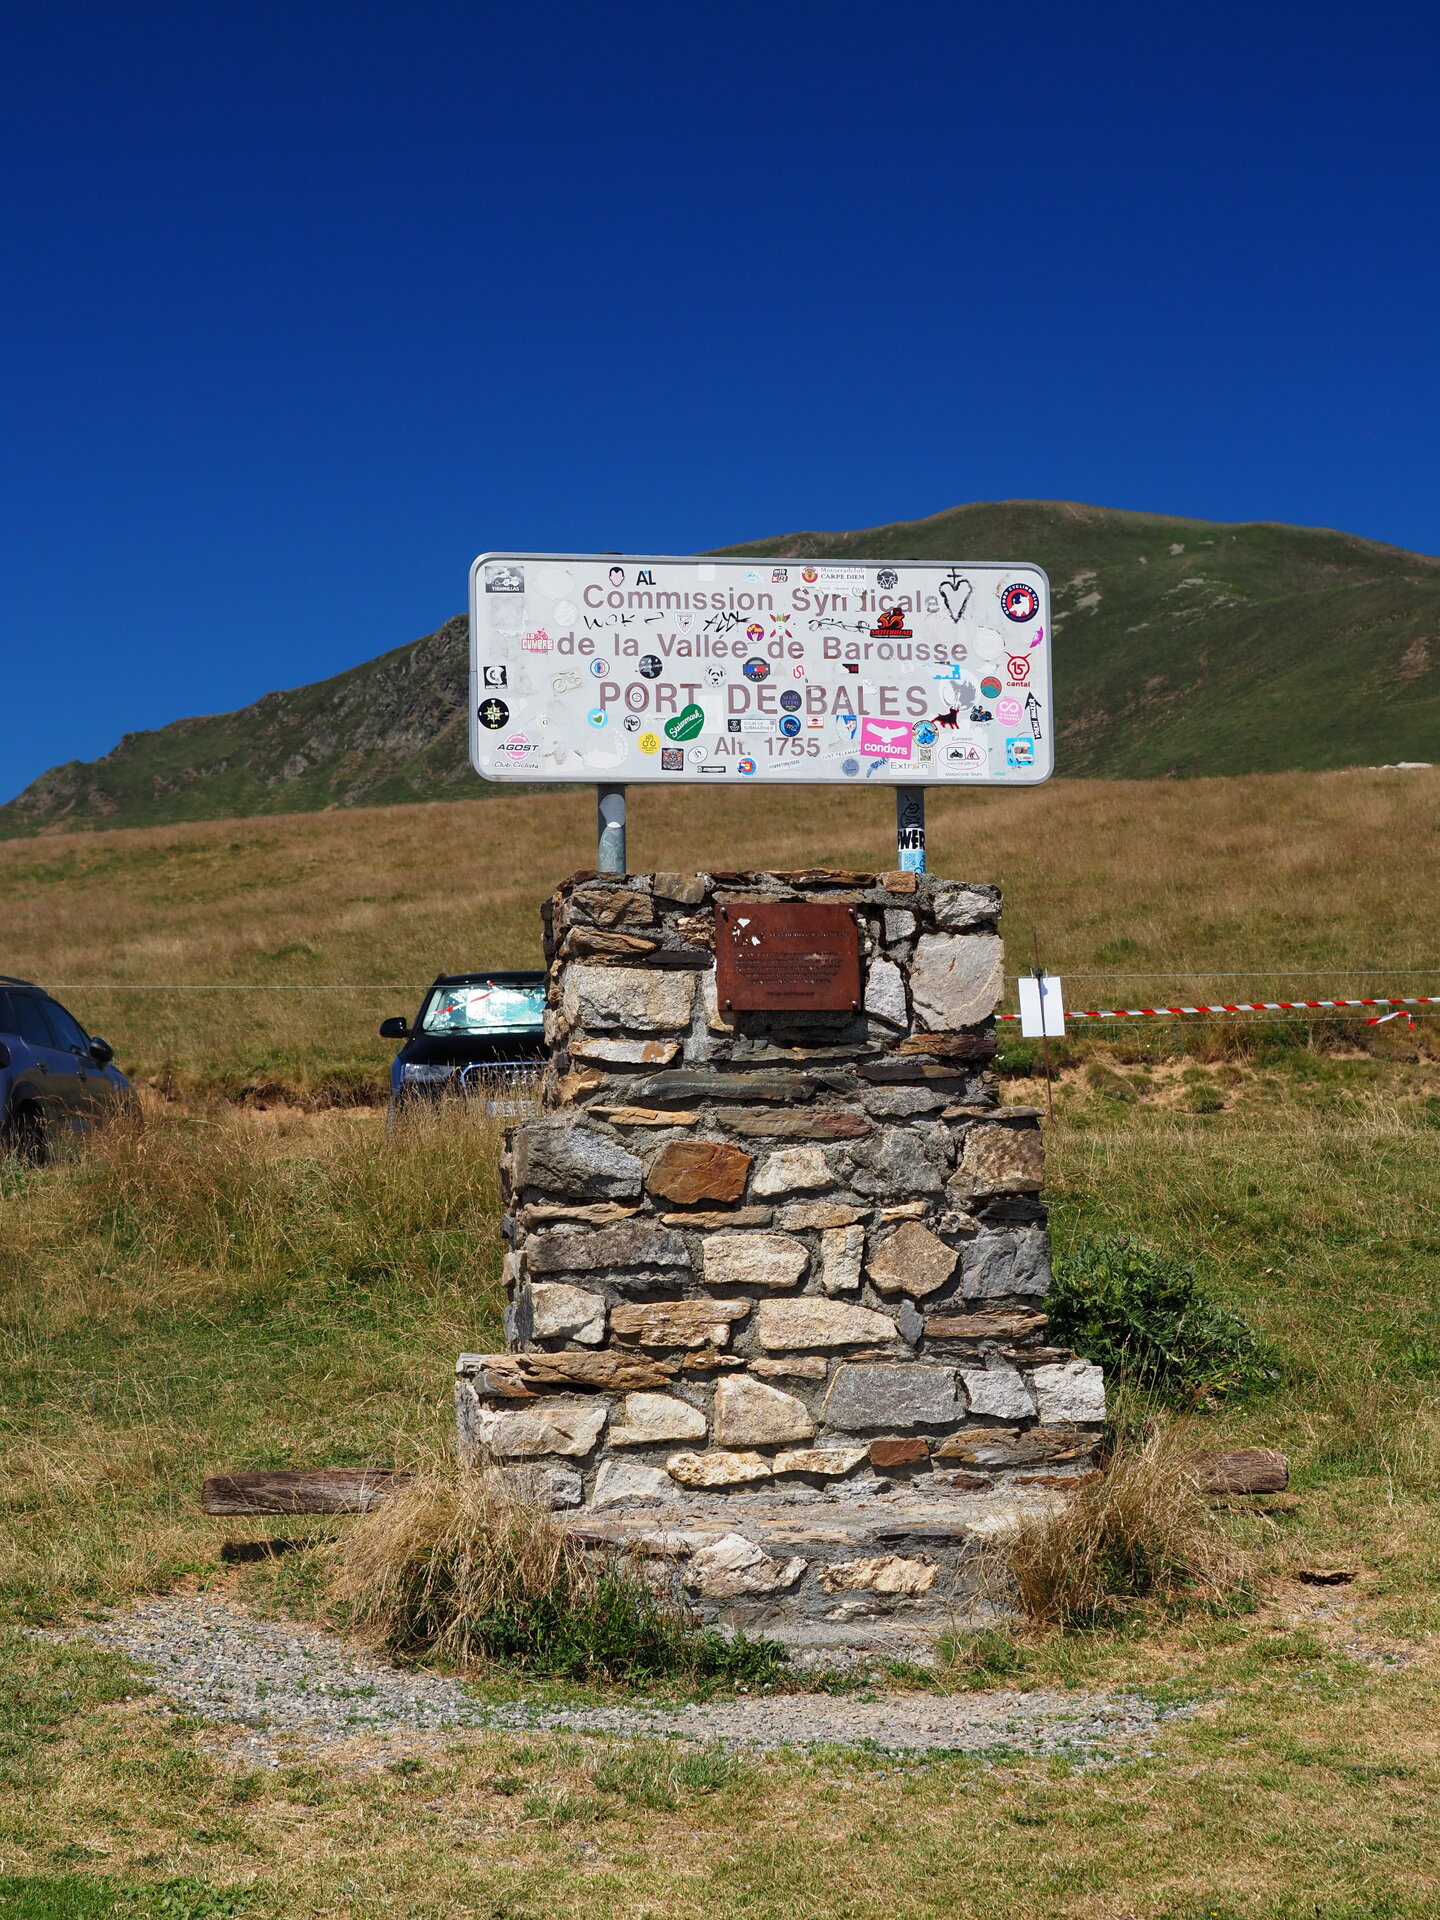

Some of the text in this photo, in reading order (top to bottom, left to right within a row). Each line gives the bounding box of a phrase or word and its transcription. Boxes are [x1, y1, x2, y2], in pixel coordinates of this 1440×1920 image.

[1009, 583, 1032, 593] CYCLING
[583, 584, 940, 617] Commission Syndicale
[557, 631, 968, 662] de la Vallée de Barousse
[599, 681, 703, 714] PORT
[727, 683, 778, 715] DE
[805, 684, 928, 717] BALES
[497, 743, 539, 751] AGOST
[714, 736, 820, 757] Alt. 1755
[864, 742, 908, 755] condors
[512, 761, 539, 769] Ciclista
